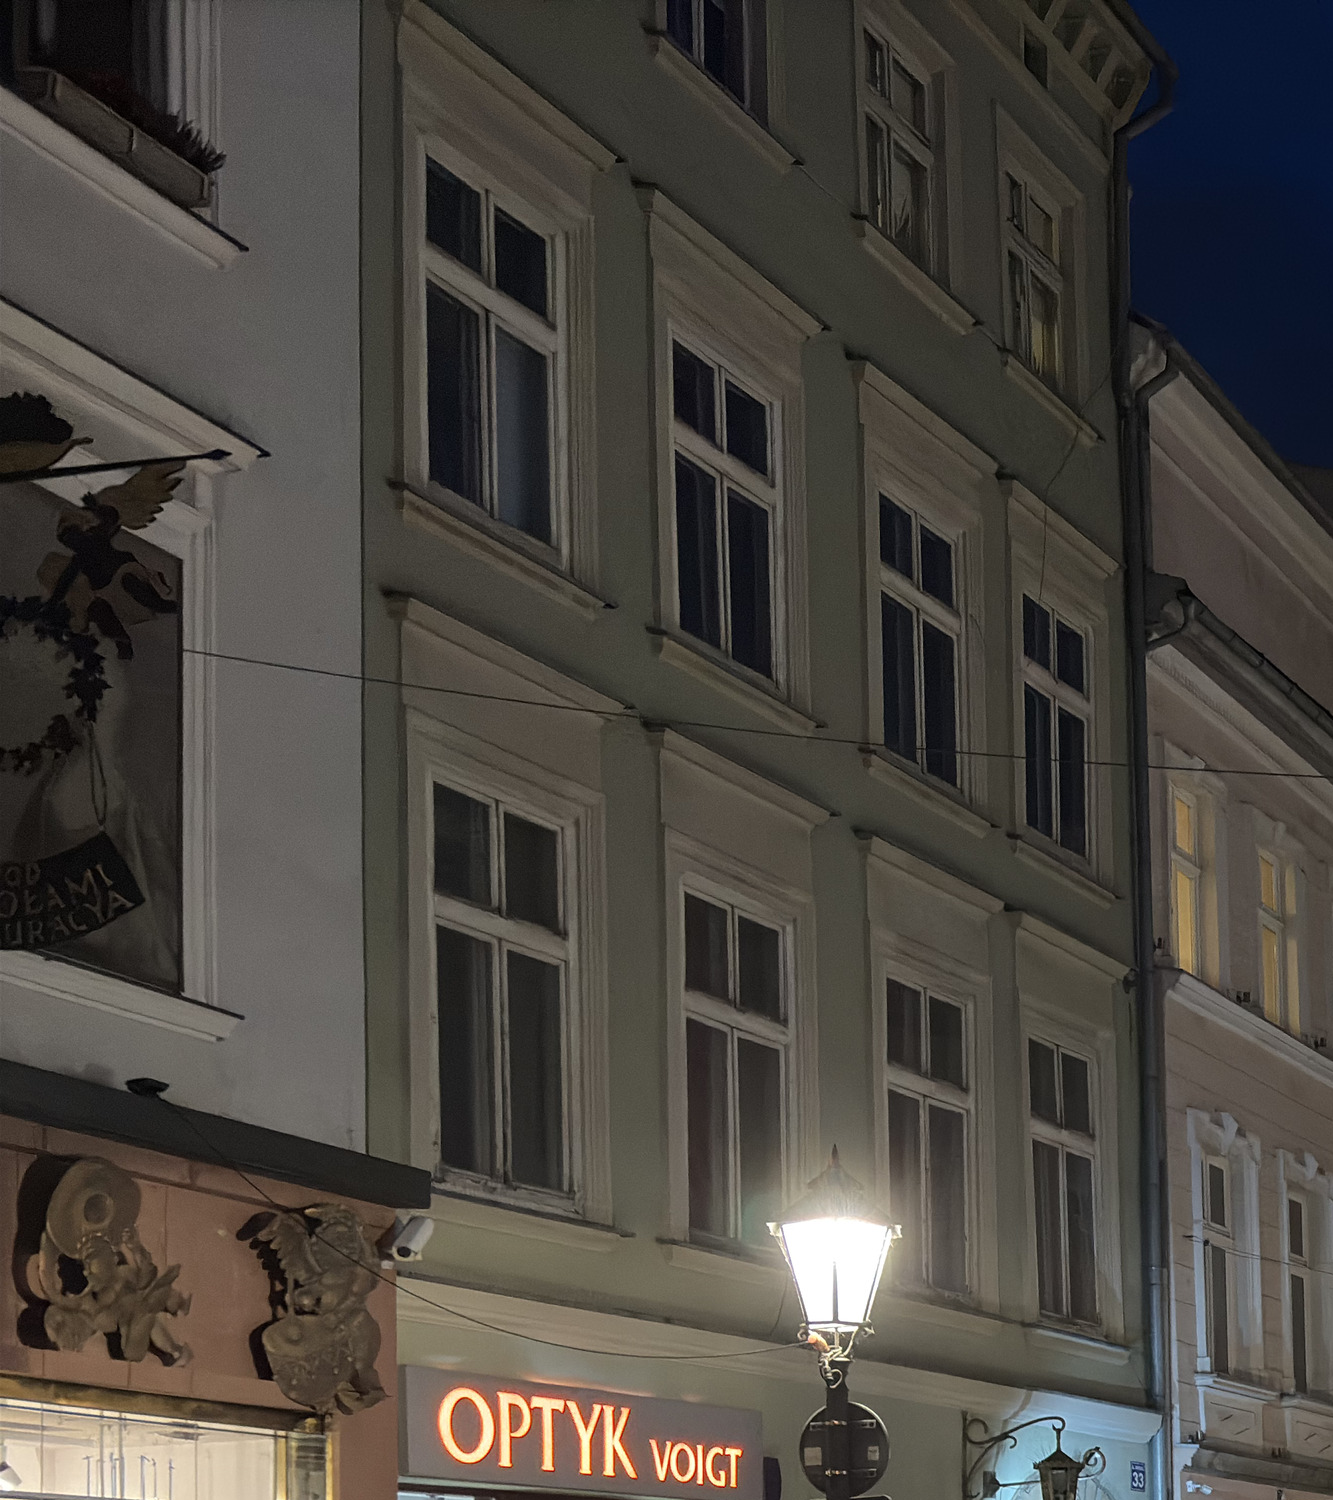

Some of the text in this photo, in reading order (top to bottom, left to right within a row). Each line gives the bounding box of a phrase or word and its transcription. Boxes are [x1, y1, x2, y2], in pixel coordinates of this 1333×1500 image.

[438, 1387, 743, 1488] OPTYK VOIGT
[1132, 1471, 1144, 1488] 33
